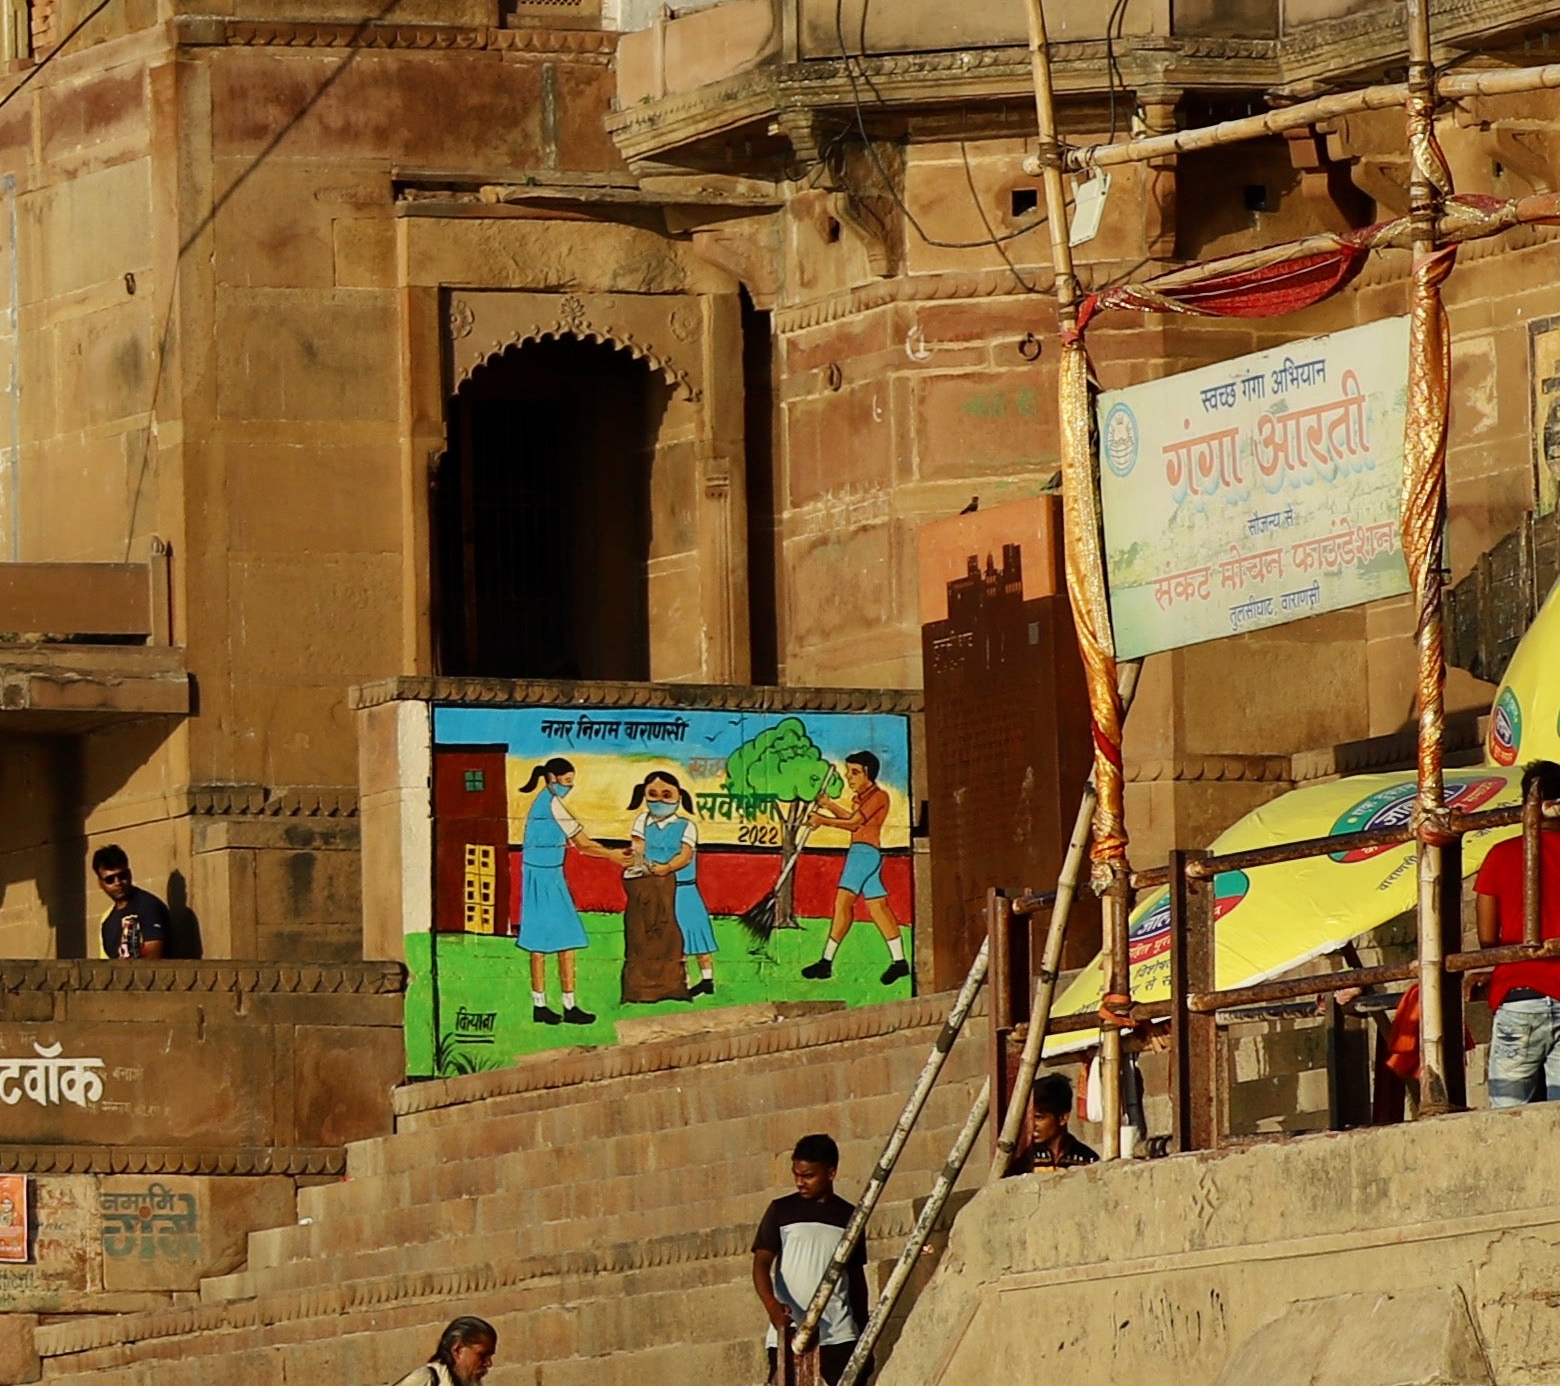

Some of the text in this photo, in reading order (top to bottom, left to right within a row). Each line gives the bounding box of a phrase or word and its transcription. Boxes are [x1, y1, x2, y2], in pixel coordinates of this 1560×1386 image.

[1200, 357, 1327, 413] स्वच्छ गंगा अभियान
[1162, 369, 1371, 495] गंगा आरती
[1153, 517, 1396, 611] संकट मोचन फाउंडेशन
[1281, 581, 1320, 613] वाराणसी
[541, 714, 691, 748] नगर निगम वाराणसी
[738, 826, 779, 845] 2022
[100, 1183, 176, 1213] नमामि
